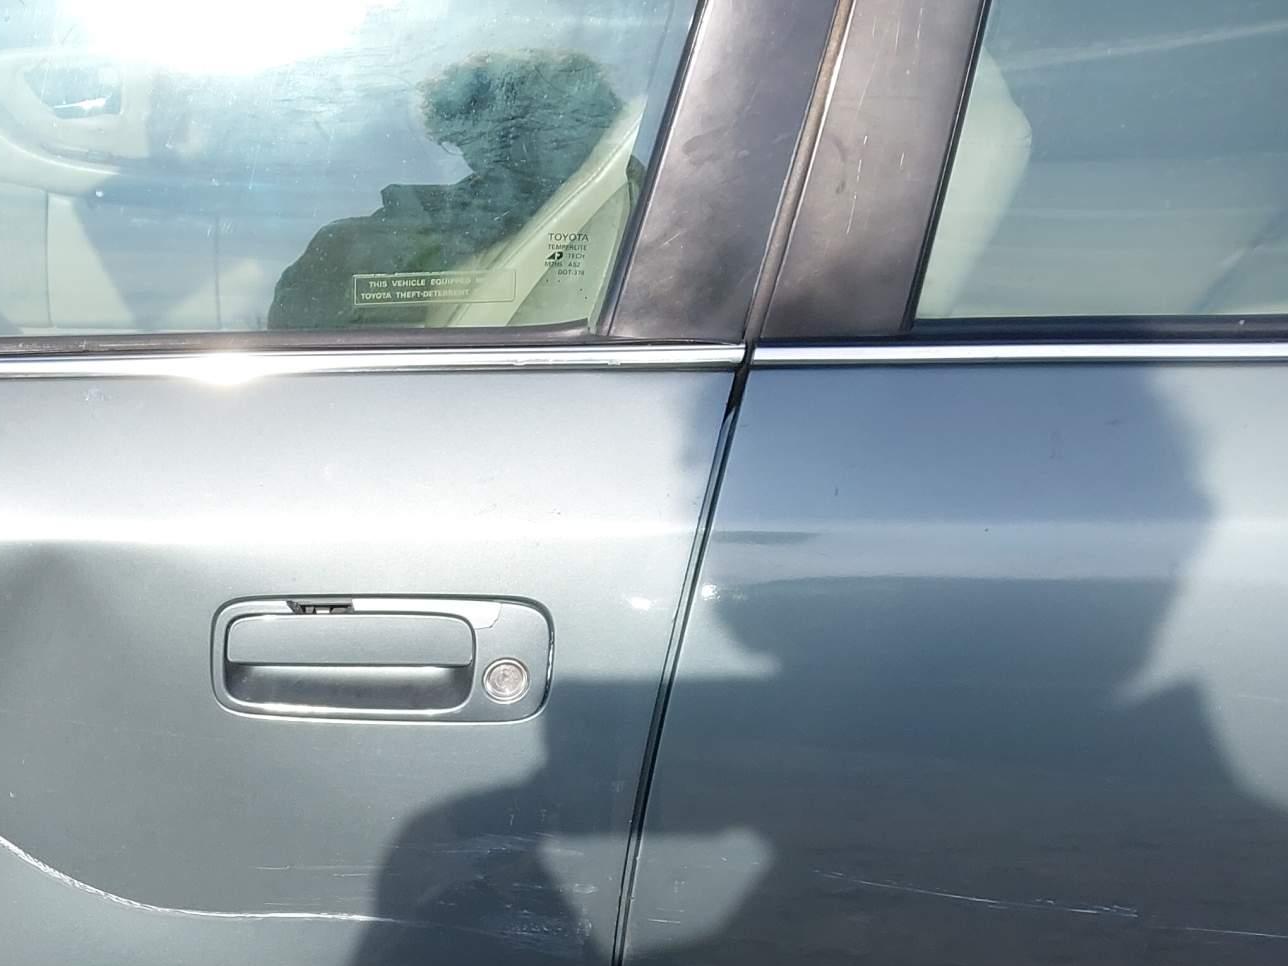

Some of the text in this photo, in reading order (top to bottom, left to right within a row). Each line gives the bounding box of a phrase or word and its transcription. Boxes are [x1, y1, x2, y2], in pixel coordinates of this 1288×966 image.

[548, 232, 589, 241] TOYOTA
[369, 280, 388, 288] THIS
[392, 279, 426, 287] VEHICLE
[360, 291, 392, 300] TOYOTA
